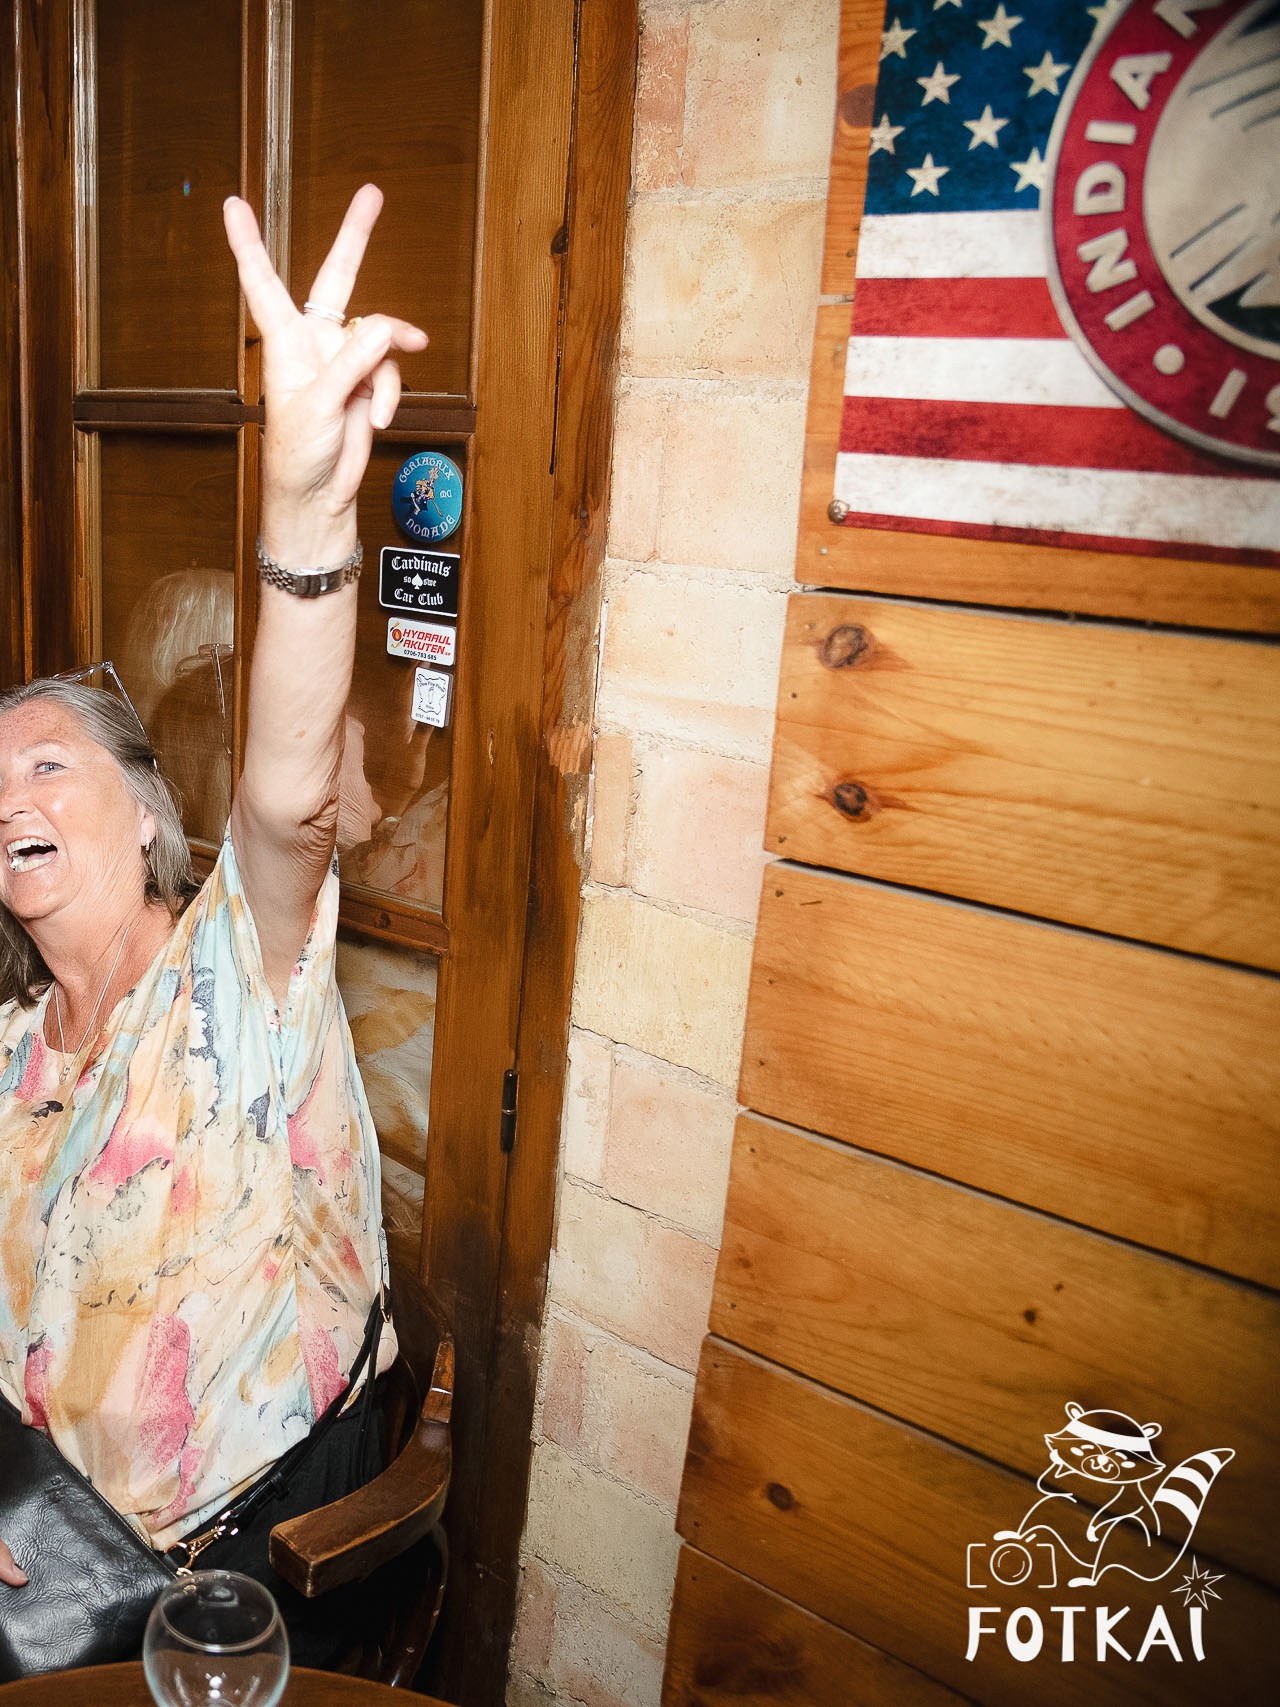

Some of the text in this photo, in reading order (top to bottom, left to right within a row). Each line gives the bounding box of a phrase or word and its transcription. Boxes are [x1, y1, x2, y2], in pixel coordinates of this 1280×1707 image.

[399, 456, 455, 483] GERIATRIX
[405, 514, 456, 539] NOMADE
[391, 555, 452, 578] Cardinals
[394, 588, 444, 606] Car Club
[402, 628, 451, 646] HYDRAUL
